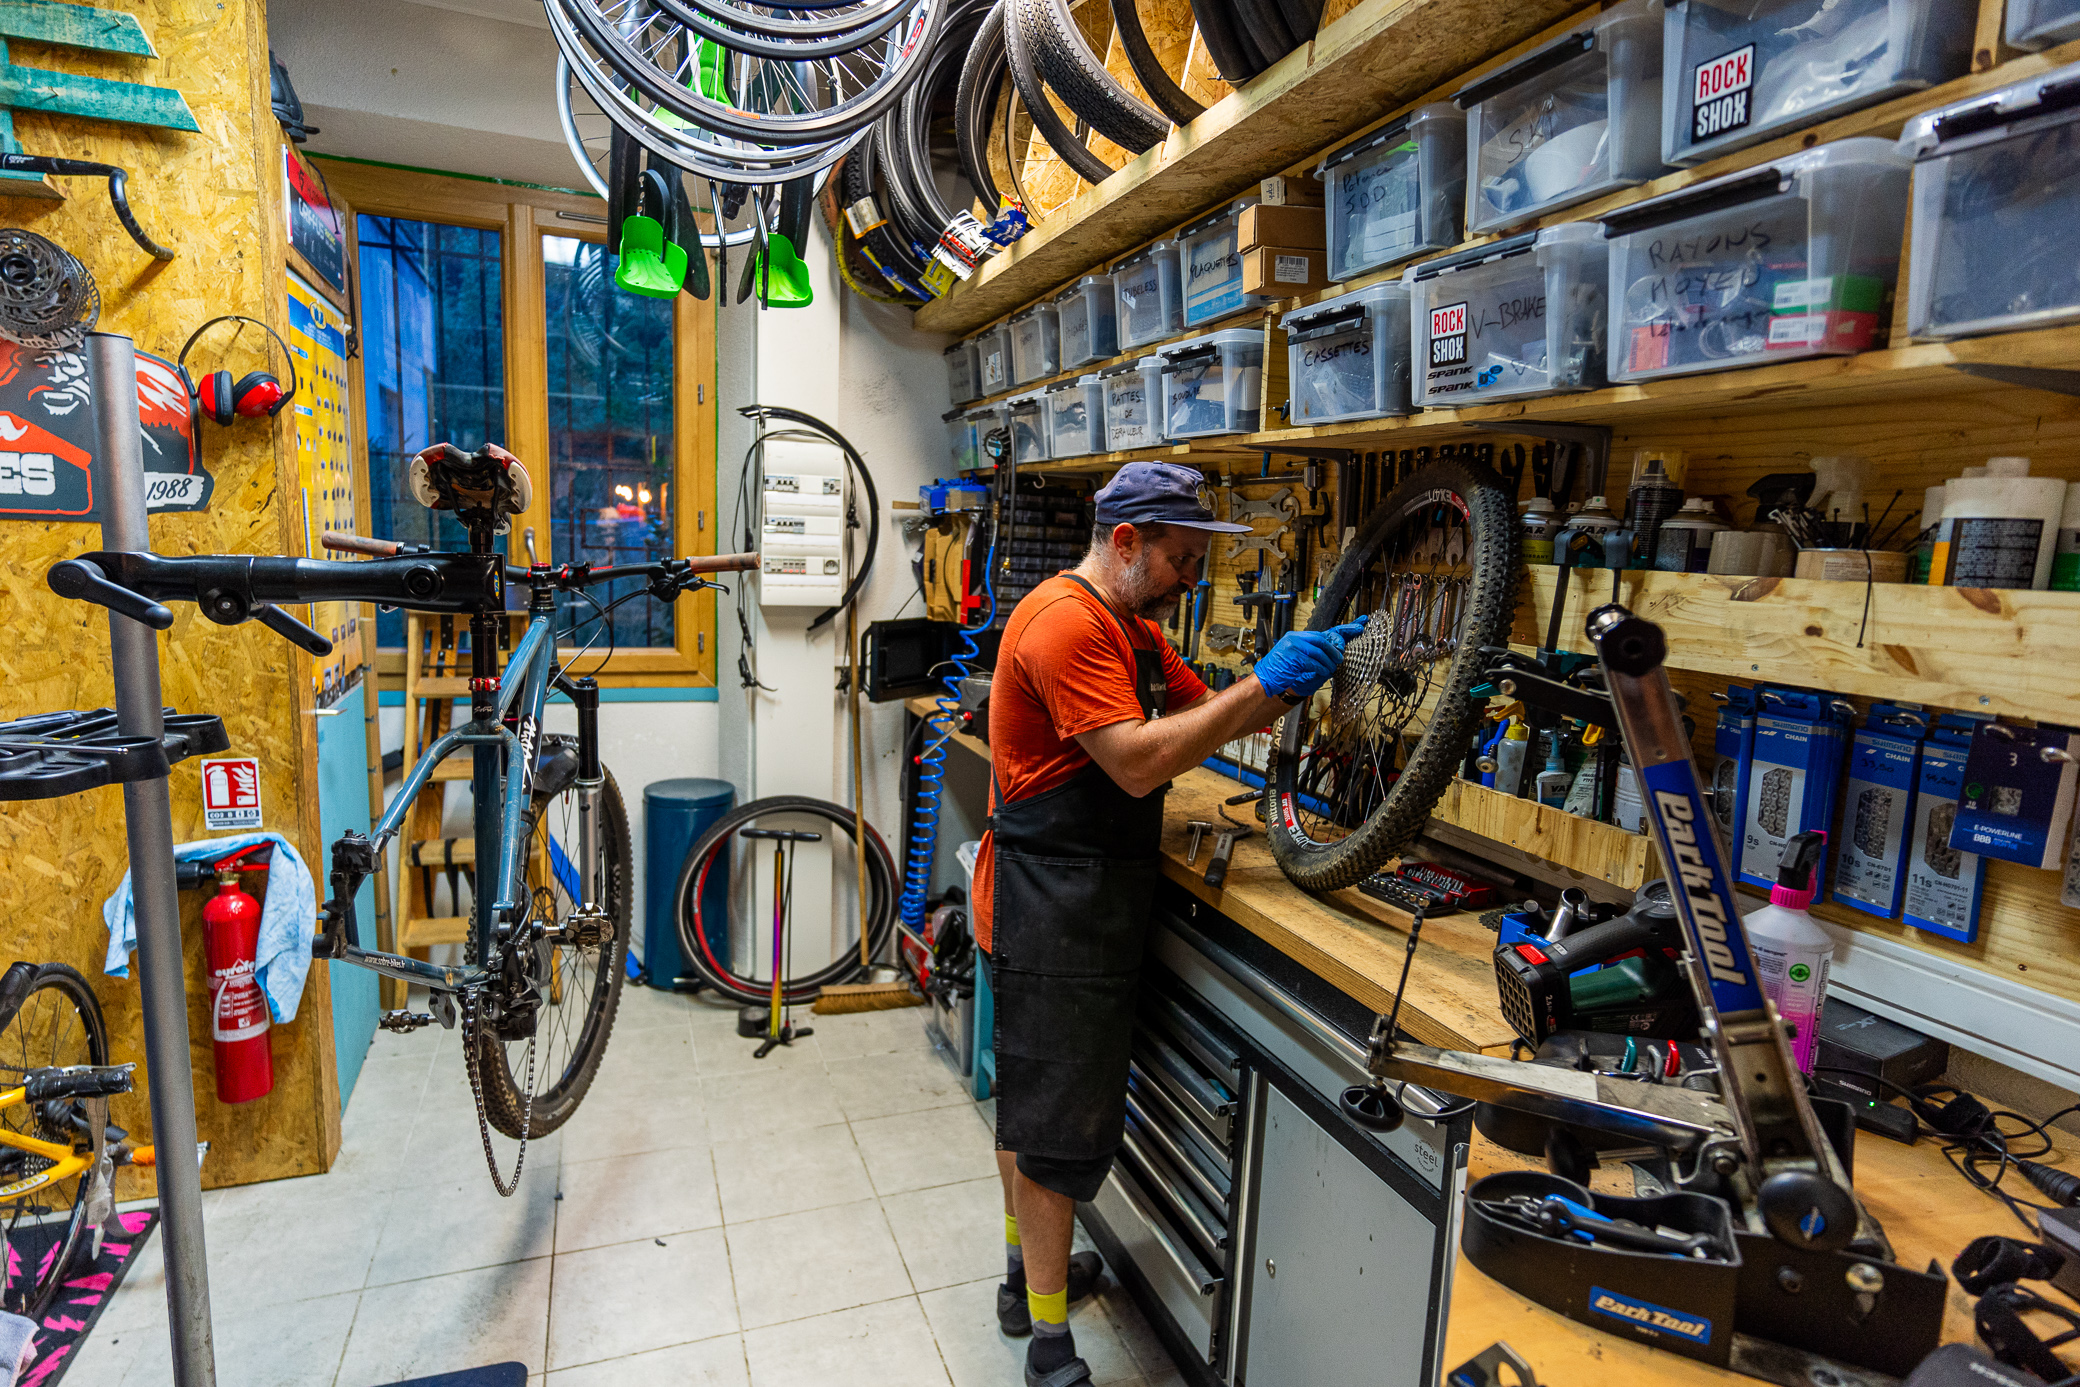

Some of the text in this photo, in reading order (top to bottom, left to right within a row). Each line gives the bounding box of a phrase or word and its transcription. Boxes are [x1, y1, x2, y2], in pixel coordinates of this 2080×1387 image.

[1699, 53, 1748, 99] ROCK
[1696, 91, 1747, 137] SHOX
[1649, 221, 1771, 269] RAYONS
[1433, 307, 1464, 335] ROCK
[1471, 296, 1547, 339] V-BRAKE
[1304, 340, 1370, 367] CASSETTES
[1433, 336, 1464, 363] SHOX
[1111, 391, 1141, 405] PATTES
[147, 478, 193, 500] 1988
[1772, 720, 1809, 733] SHIMANO
[1785, 733, 1808, 743] CHAIN
[1872, 739, 1912, 753] SHIMANO
[1269, 715, 1286, 784] SAGUARO
[1885, 752, 1911, 763] CHAIN
[1973, 833, 1992, 844] BBB
[1913, 873, 1932, 888] 11s
[1839, 1080, 1872, 1096] SHIMANO
[1414, 1144, 1438, 1167] steel
